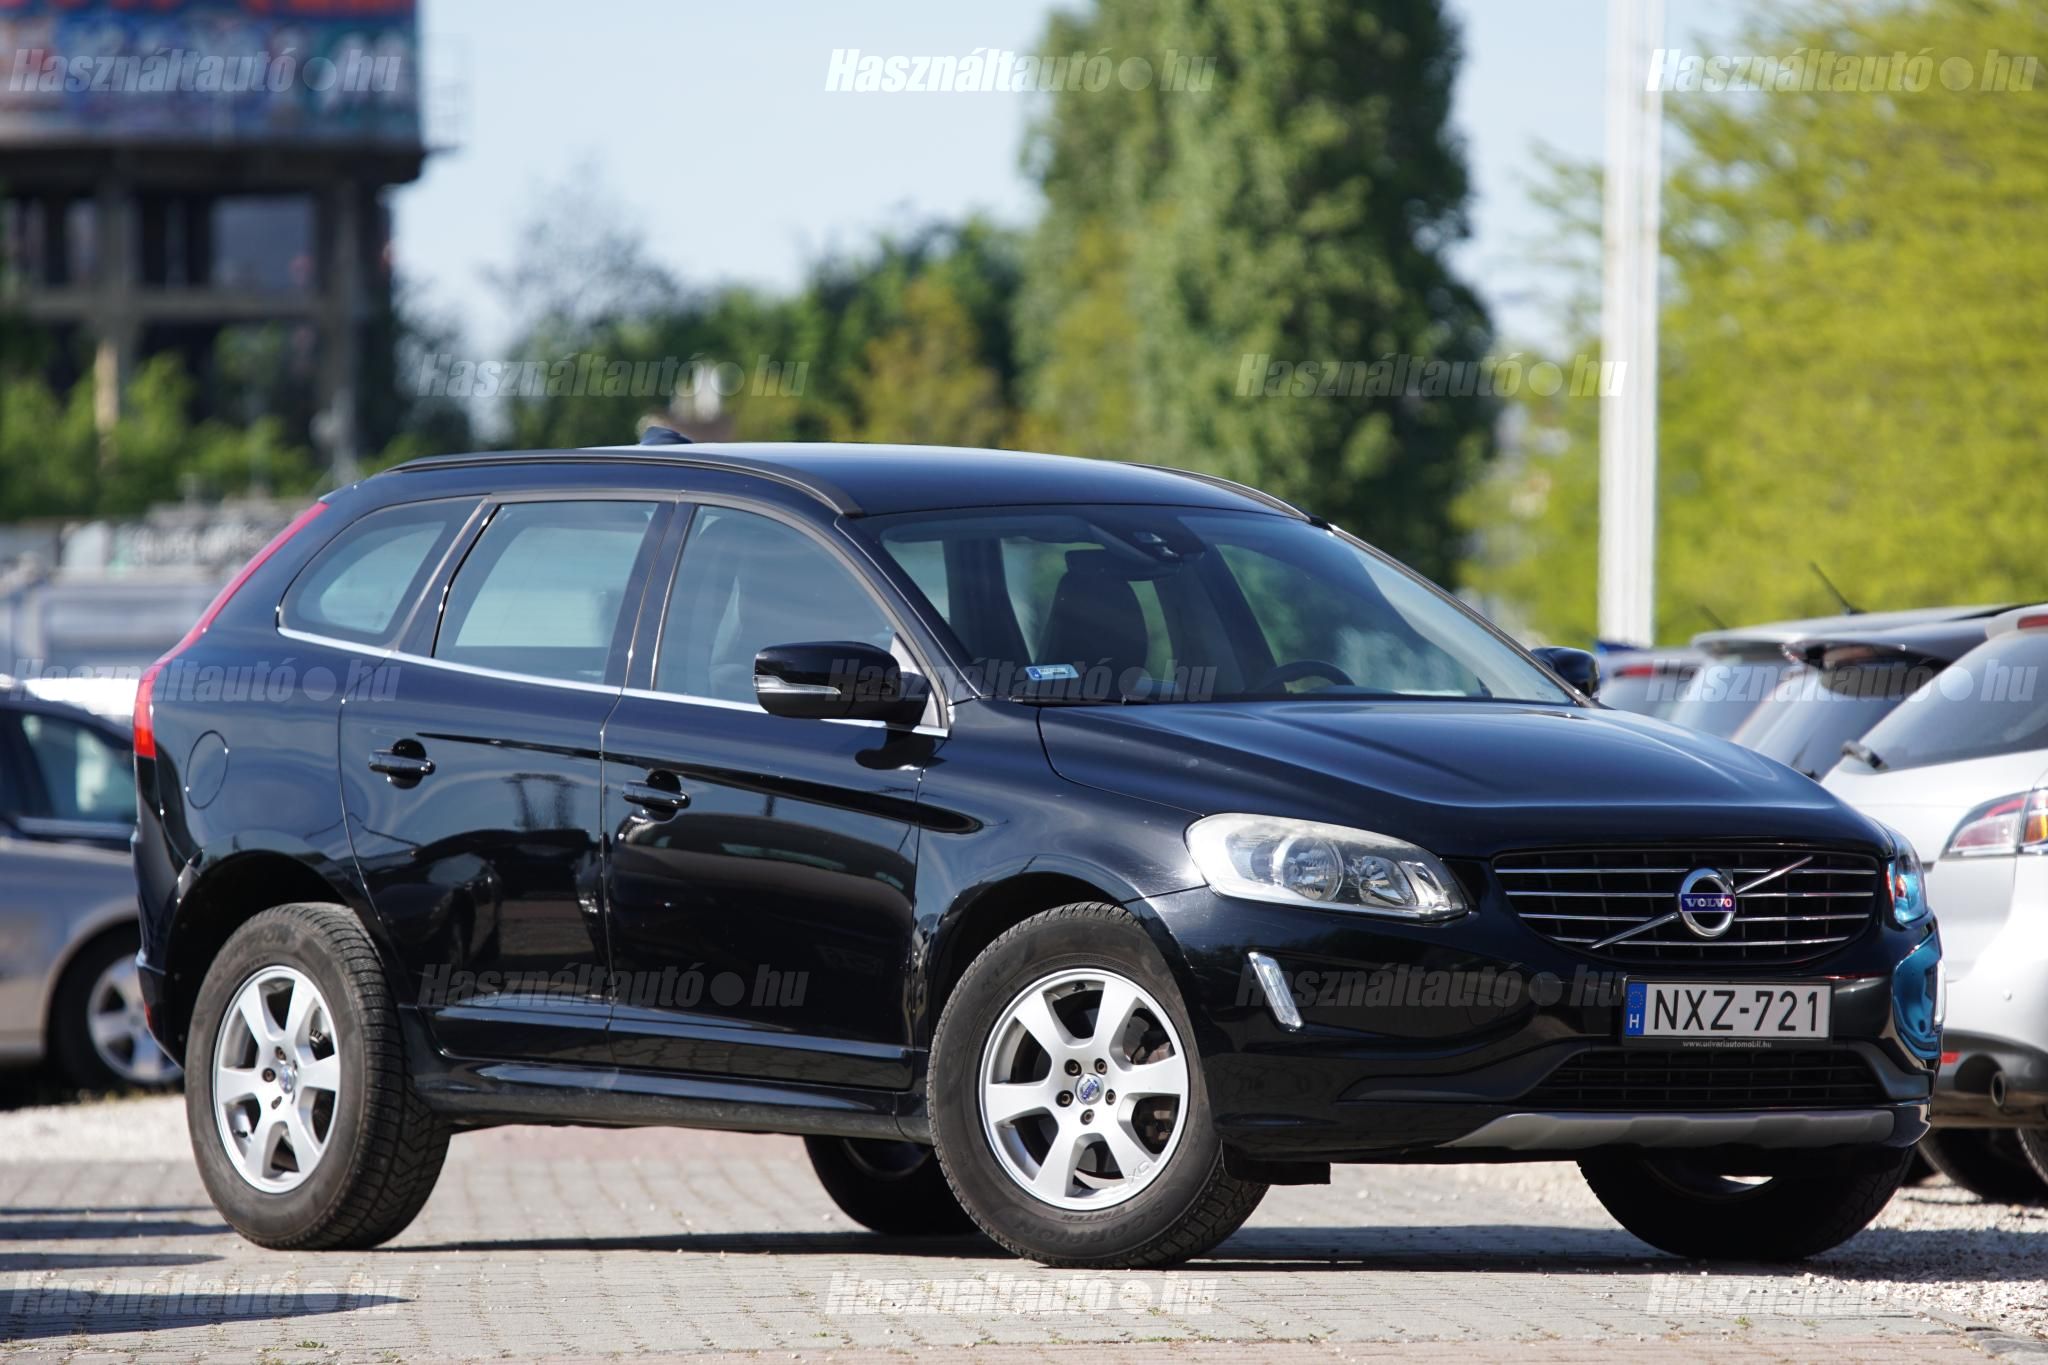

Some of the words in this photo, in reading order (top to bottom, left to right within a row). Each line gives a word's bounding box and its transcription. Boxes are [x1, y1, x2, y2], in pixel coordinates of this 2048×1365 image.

[1684, 896, 1733, 908] VOLVO
[1653, 989, 1818, 1032] NXZ-721
[1629, 1014, 1640, 1029] H
